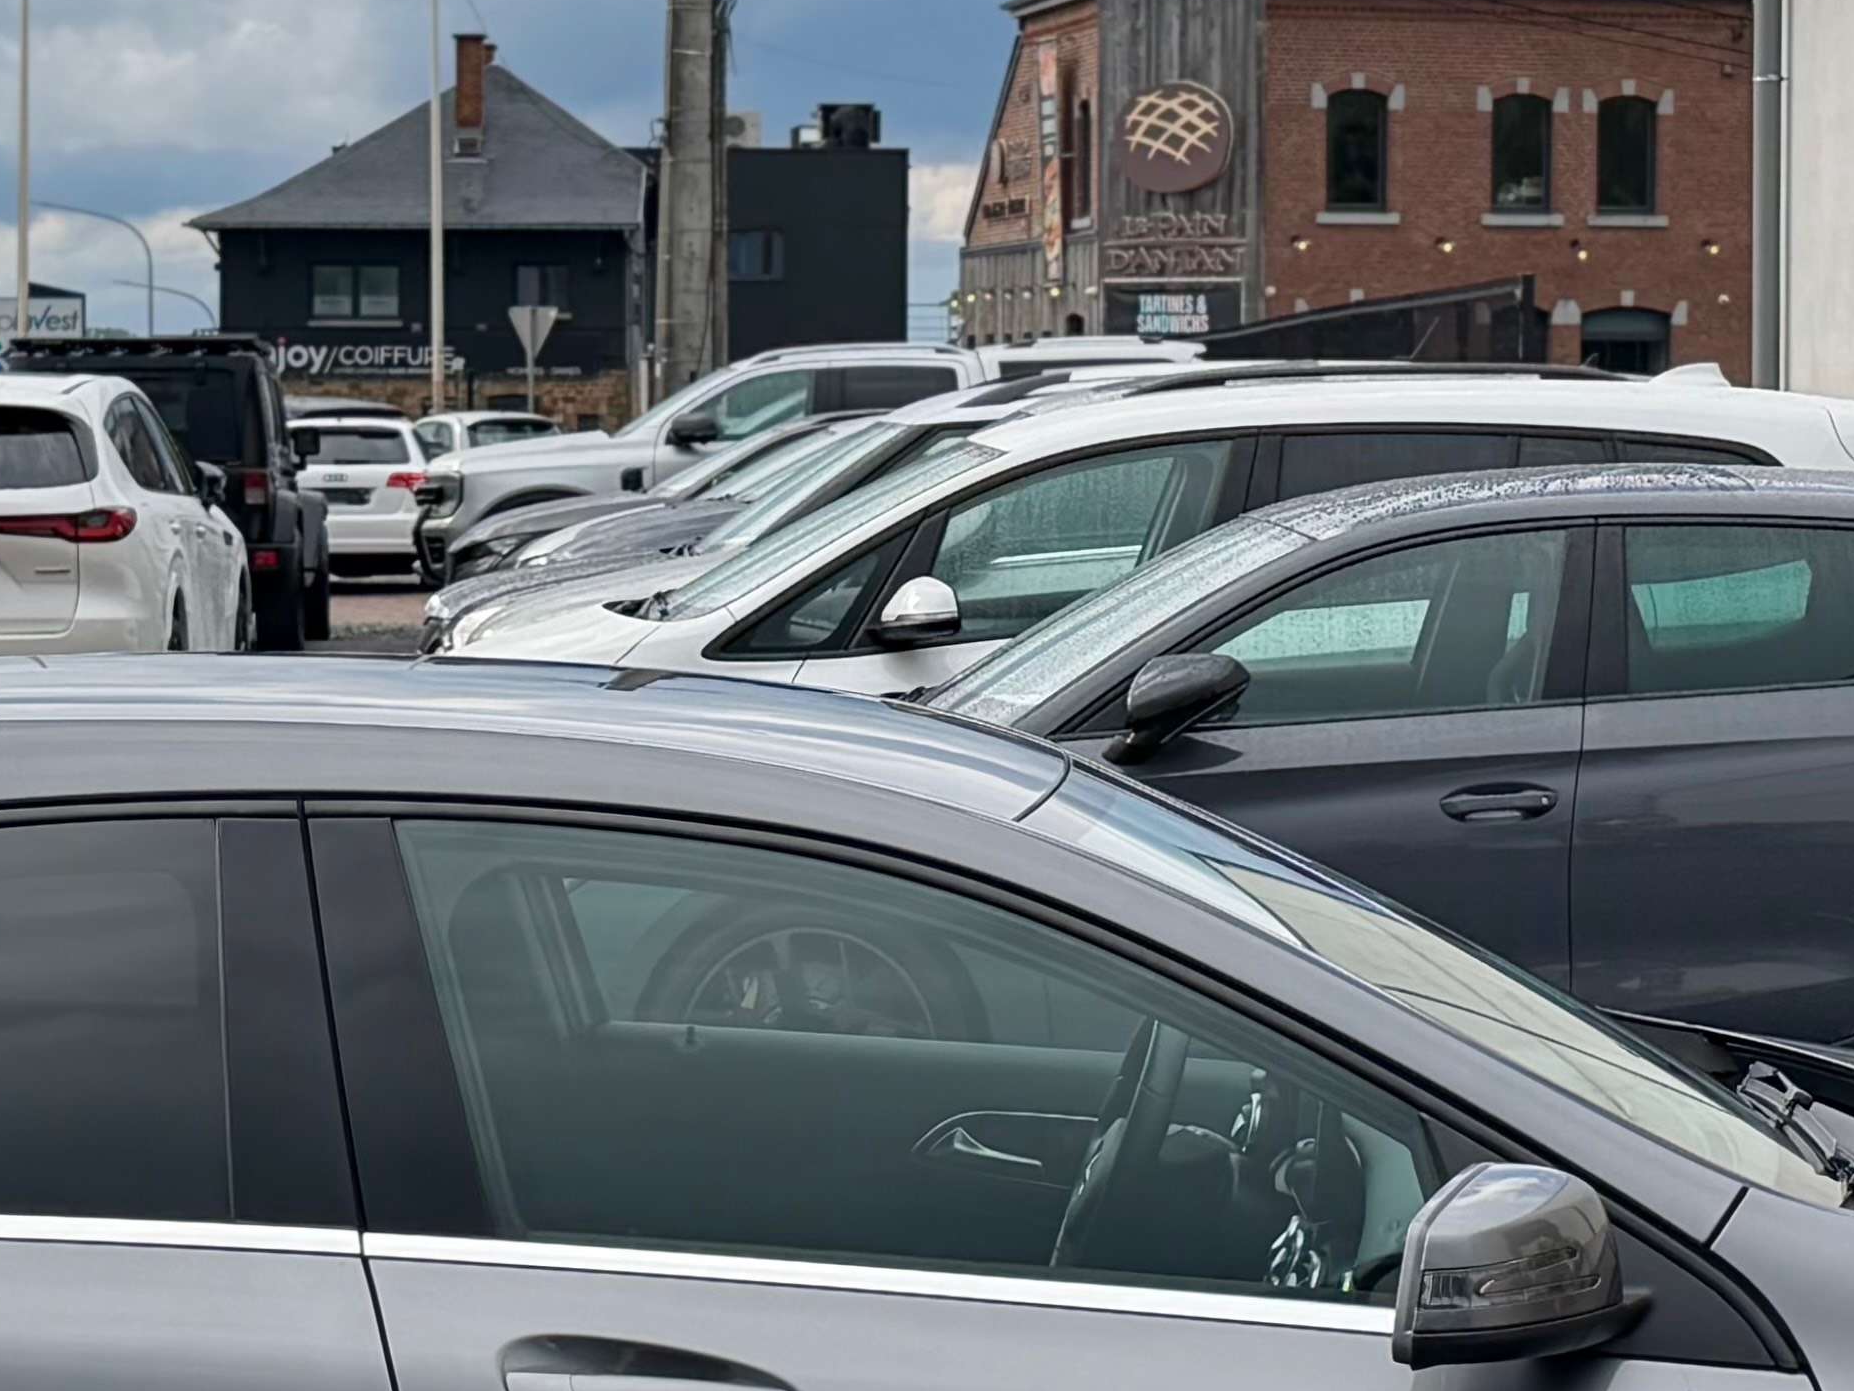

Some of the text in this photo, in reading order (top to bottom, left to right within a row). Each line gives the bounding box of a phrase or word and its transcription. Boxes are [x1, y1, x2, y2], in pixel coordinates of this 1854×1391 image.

[1138, 294, 1207, 313] TARTINES &
[1137, 314, 1209, 333] SANDWICHS
